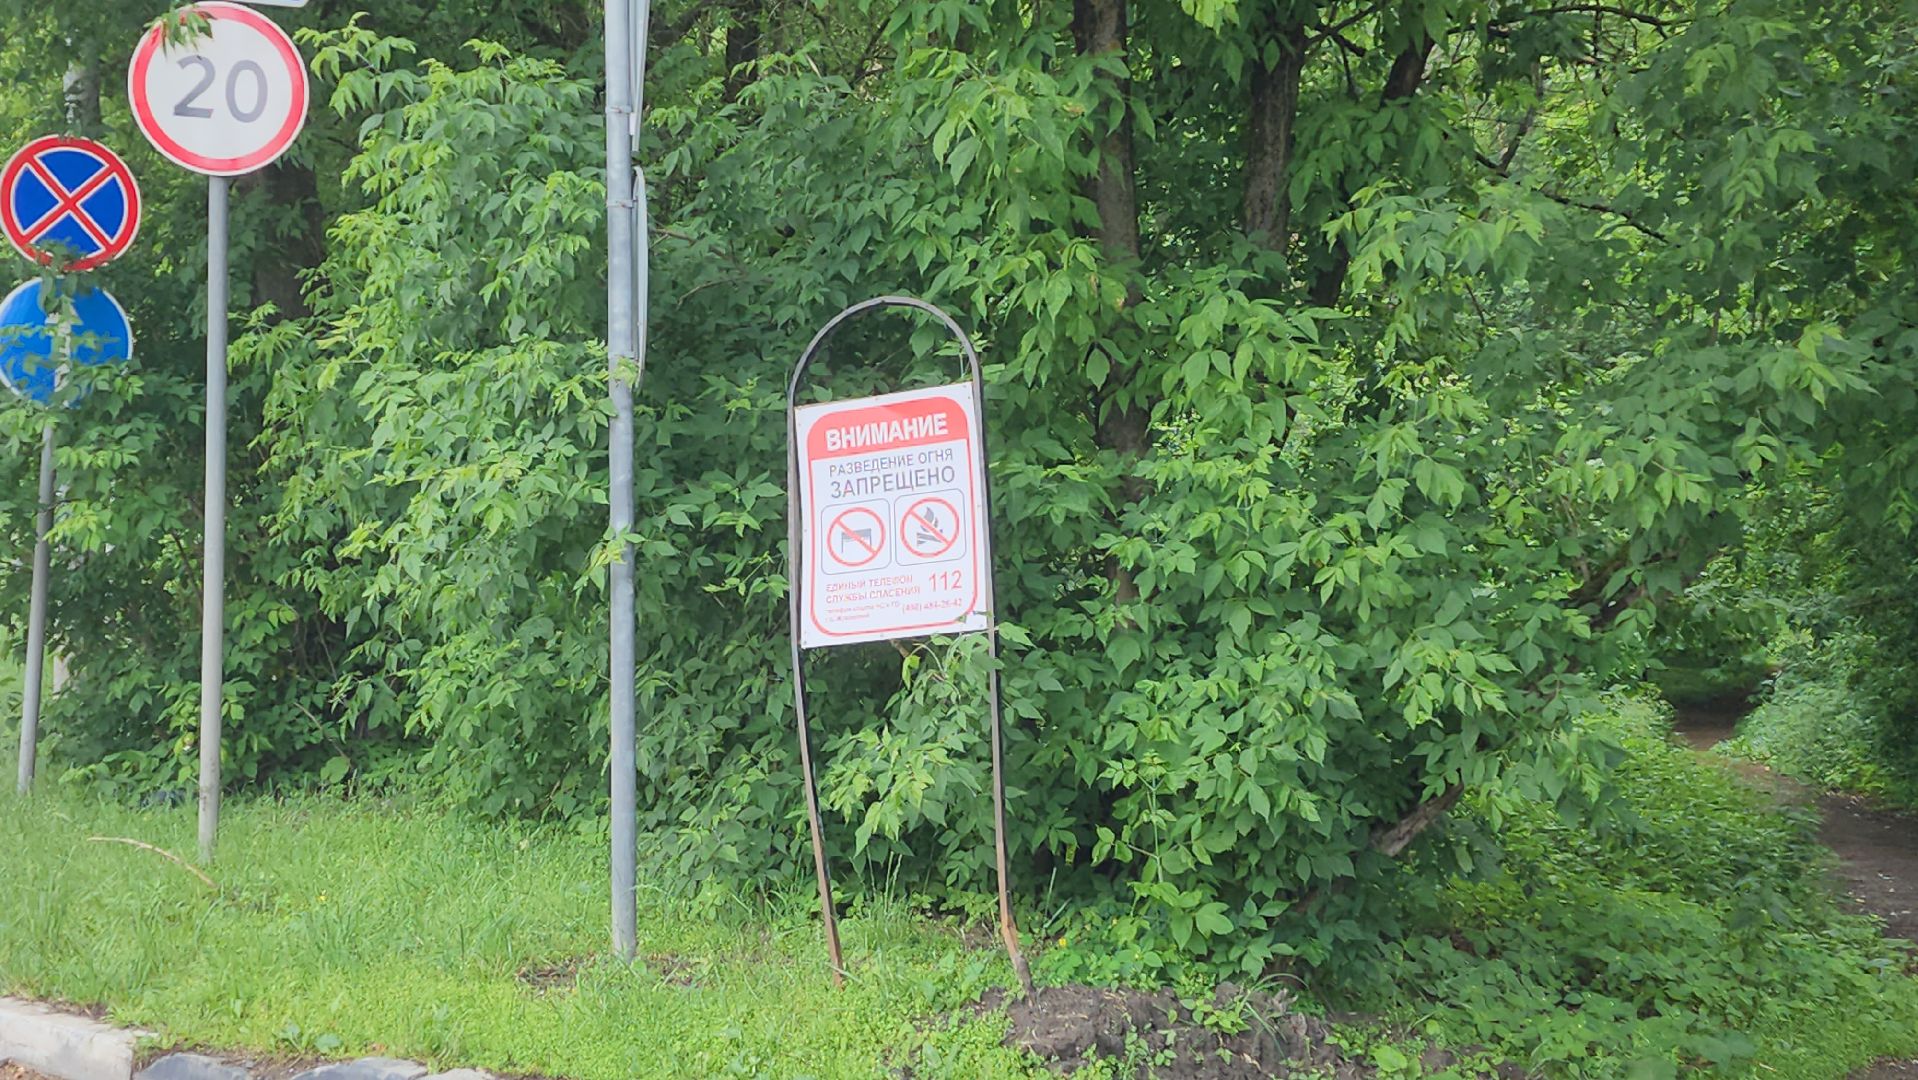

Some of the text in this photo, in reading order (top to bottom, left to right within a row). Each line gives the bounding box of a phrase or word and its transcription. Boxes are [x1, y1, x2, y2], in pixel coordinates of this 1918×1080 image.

[173, 54, 268, 123] 20
[825, 412, 949, 452] ВНИМАНИЕ
[829, 448, 953, 477] РАЗВЕДЕНИЕ ОГНЯ
[831, 465, 955, 499] ЗАПРЕЩЕНО
[825, 574, 913, 593] ЕДИНЫЙ ТЕЛЕФОН
[825, 586, 921, 604] СЛУЖБЫ СПАСЕНИЯ
[929, 569, 962, 592] 112
